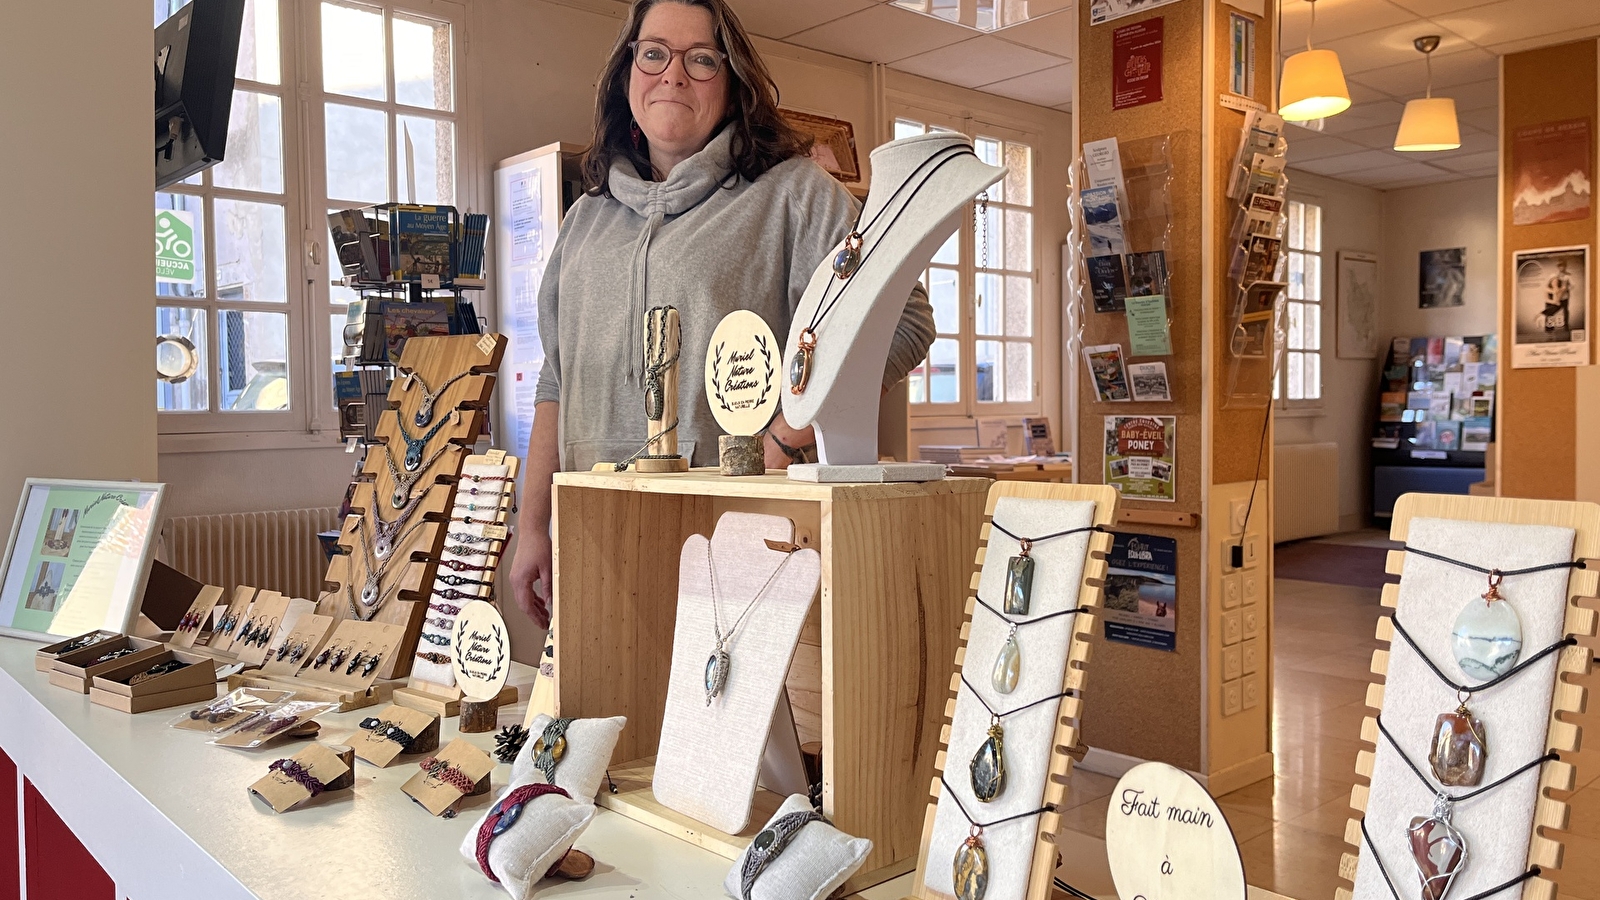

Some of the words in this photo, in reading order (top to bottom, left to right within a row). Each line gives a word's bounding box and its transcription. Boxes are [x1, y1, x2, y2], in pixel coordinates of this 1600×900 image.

[423, 214, 447, 223] guerre
[415, 222, 435, 231] Moyen
[436, 222, 447, 231] Âge
[727, 348, 755, 365] Muriel
[727, 364, 755, 380] Nature
[725, 380, 759, 392] Créations
[1122, 429, 1163, 439] BABY-ÉVEIL
[1128, 440, 1154, 450] PONEY
[469, 630, 491, 642] Muriel
[1121, 788, 1160, 818] Fait
[1167, 806, 1214, 828] main
[1161, 854, 1173, 875] à
